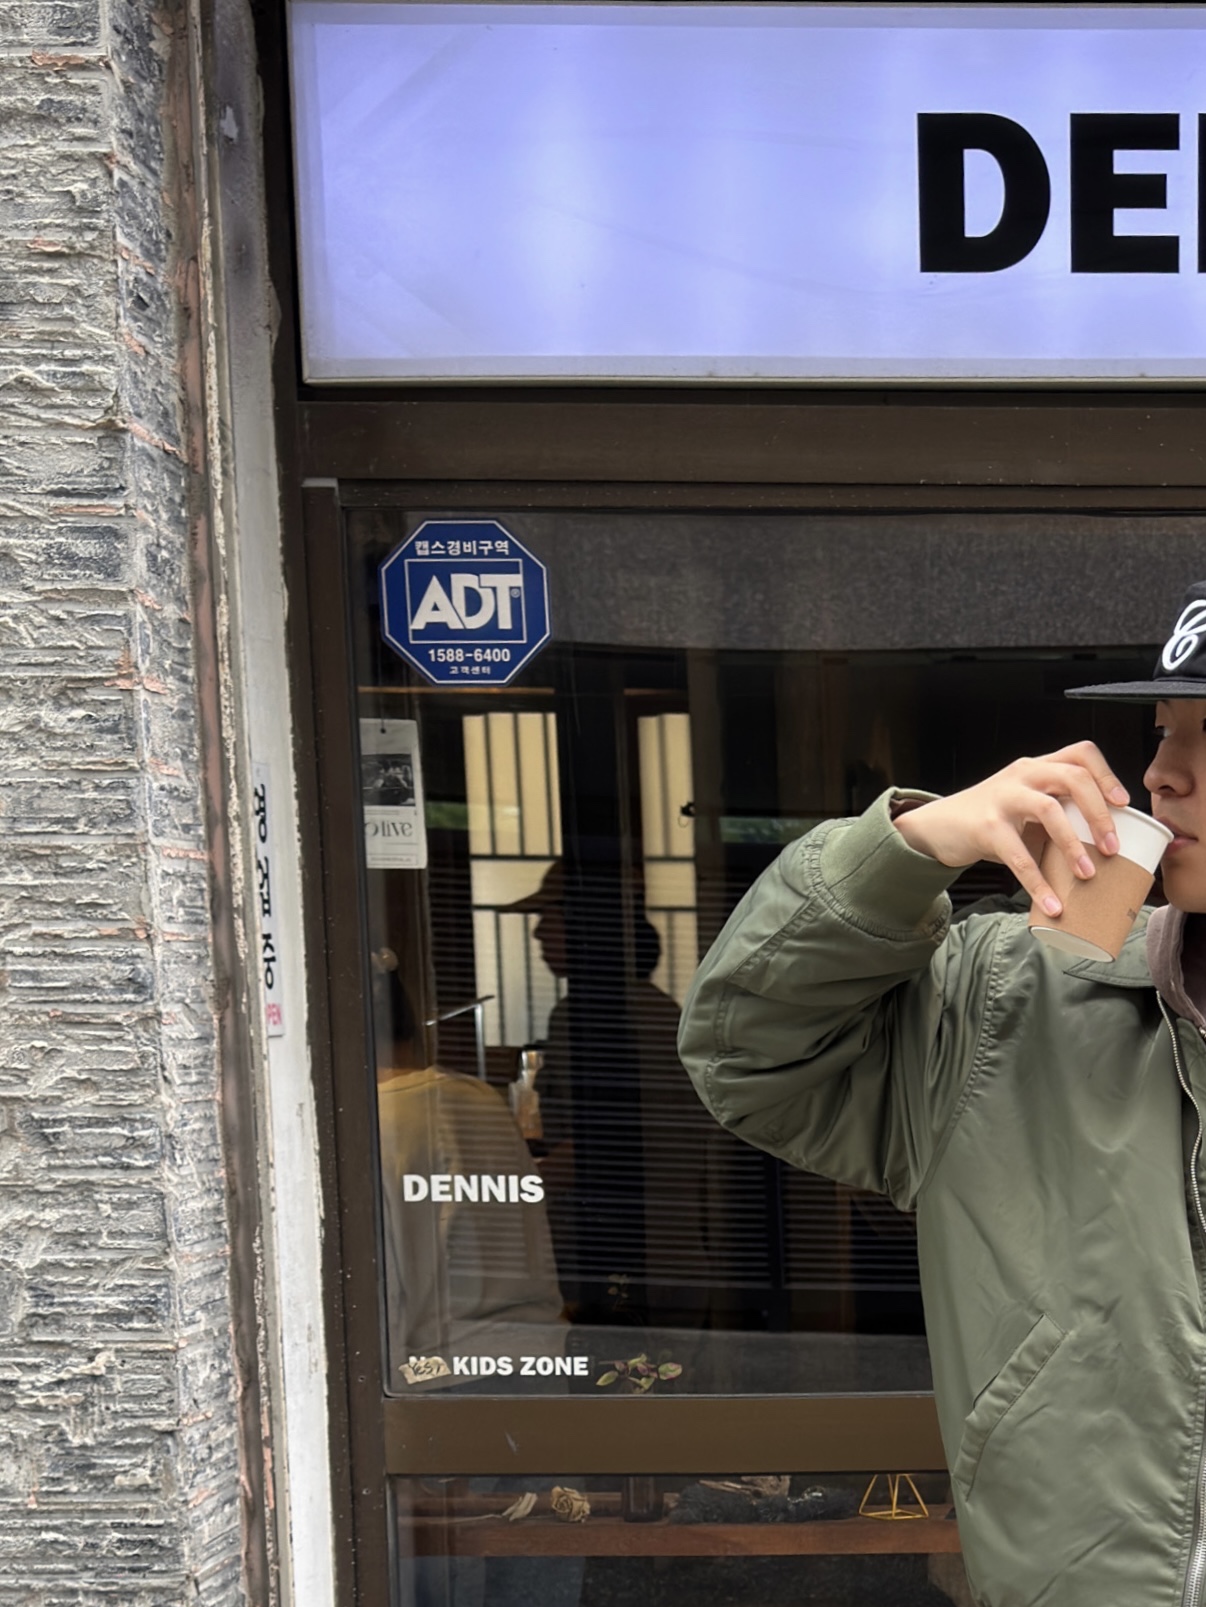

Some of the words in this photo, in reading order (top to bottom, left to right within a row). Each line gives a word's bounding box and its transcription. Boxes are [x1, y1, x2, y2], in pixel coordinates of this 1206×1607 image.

[414, 539, 510, 556] 캡스경비구역
[411, 574, 522, 629] ADT
[428, 648, 511, 663] 1588-6400
[449, 666, 491, 675] 고객센터
[403, 1174, 544, 1203] DENNIS
[453, 1356, 513, 1376] KIDS
[520, 1356, 588, 1376] ZONE
